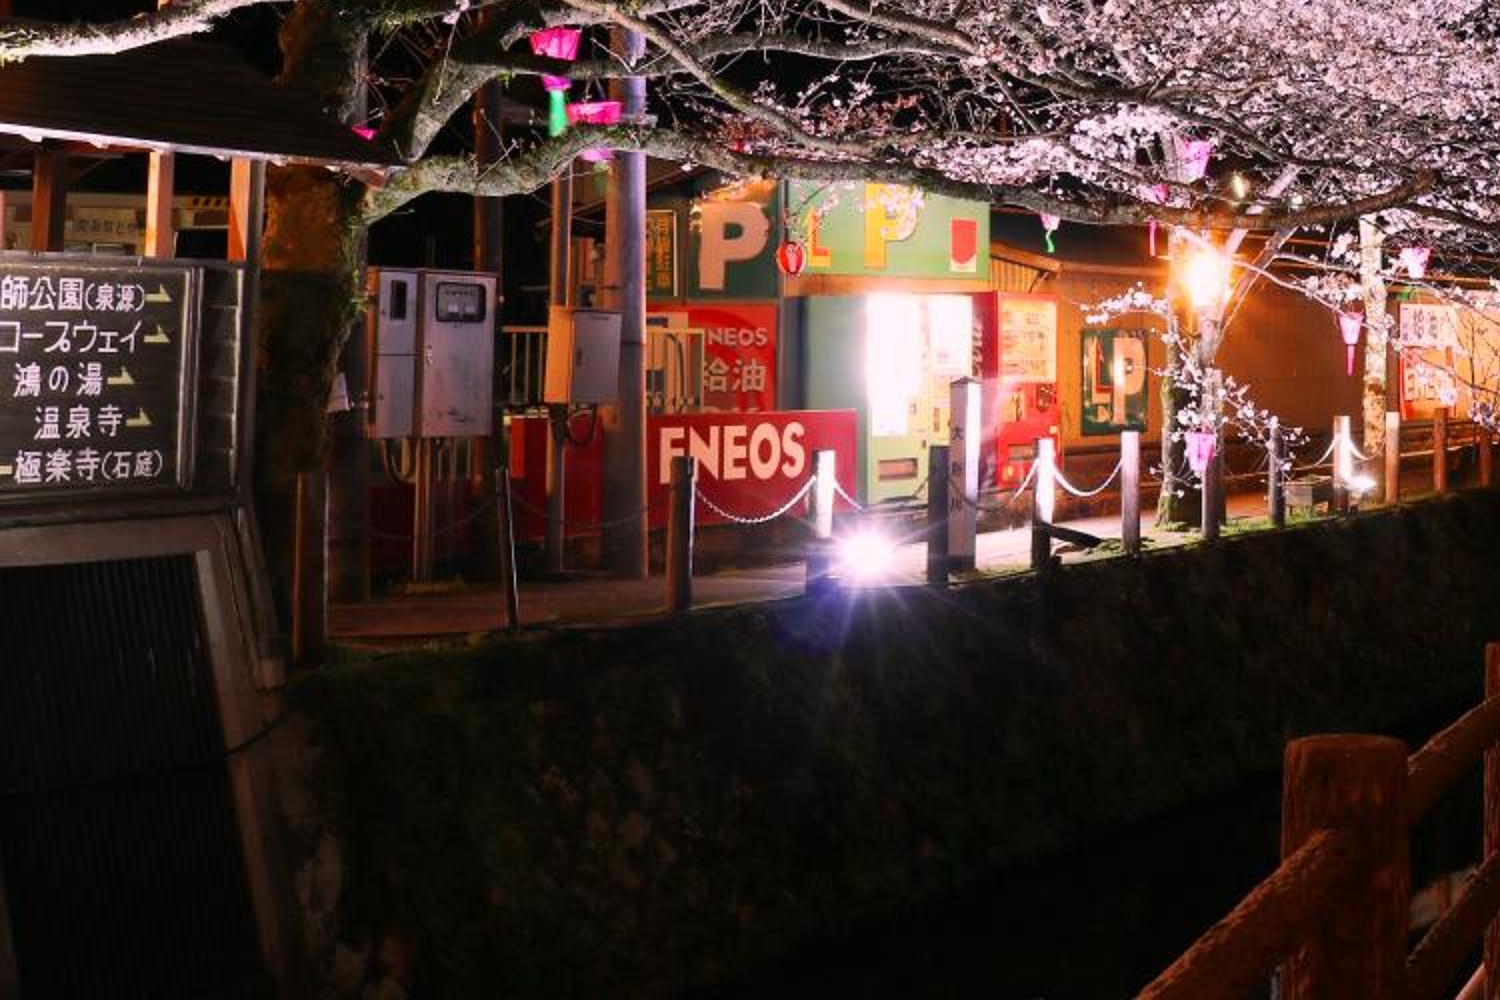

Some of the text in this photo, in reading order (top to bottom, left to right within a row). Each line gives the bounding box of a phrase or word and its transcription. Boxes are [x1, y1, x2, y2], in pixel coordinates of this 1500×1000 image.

[700, 202, 769, 290] P
[707, 327, 768, 347] NEOS
[13, 362, 103, 397] 鴻の湯
[34, 404, 123, 440] 温泉寺
[15, 448, 164, 484] 極楽寺(石庭)
